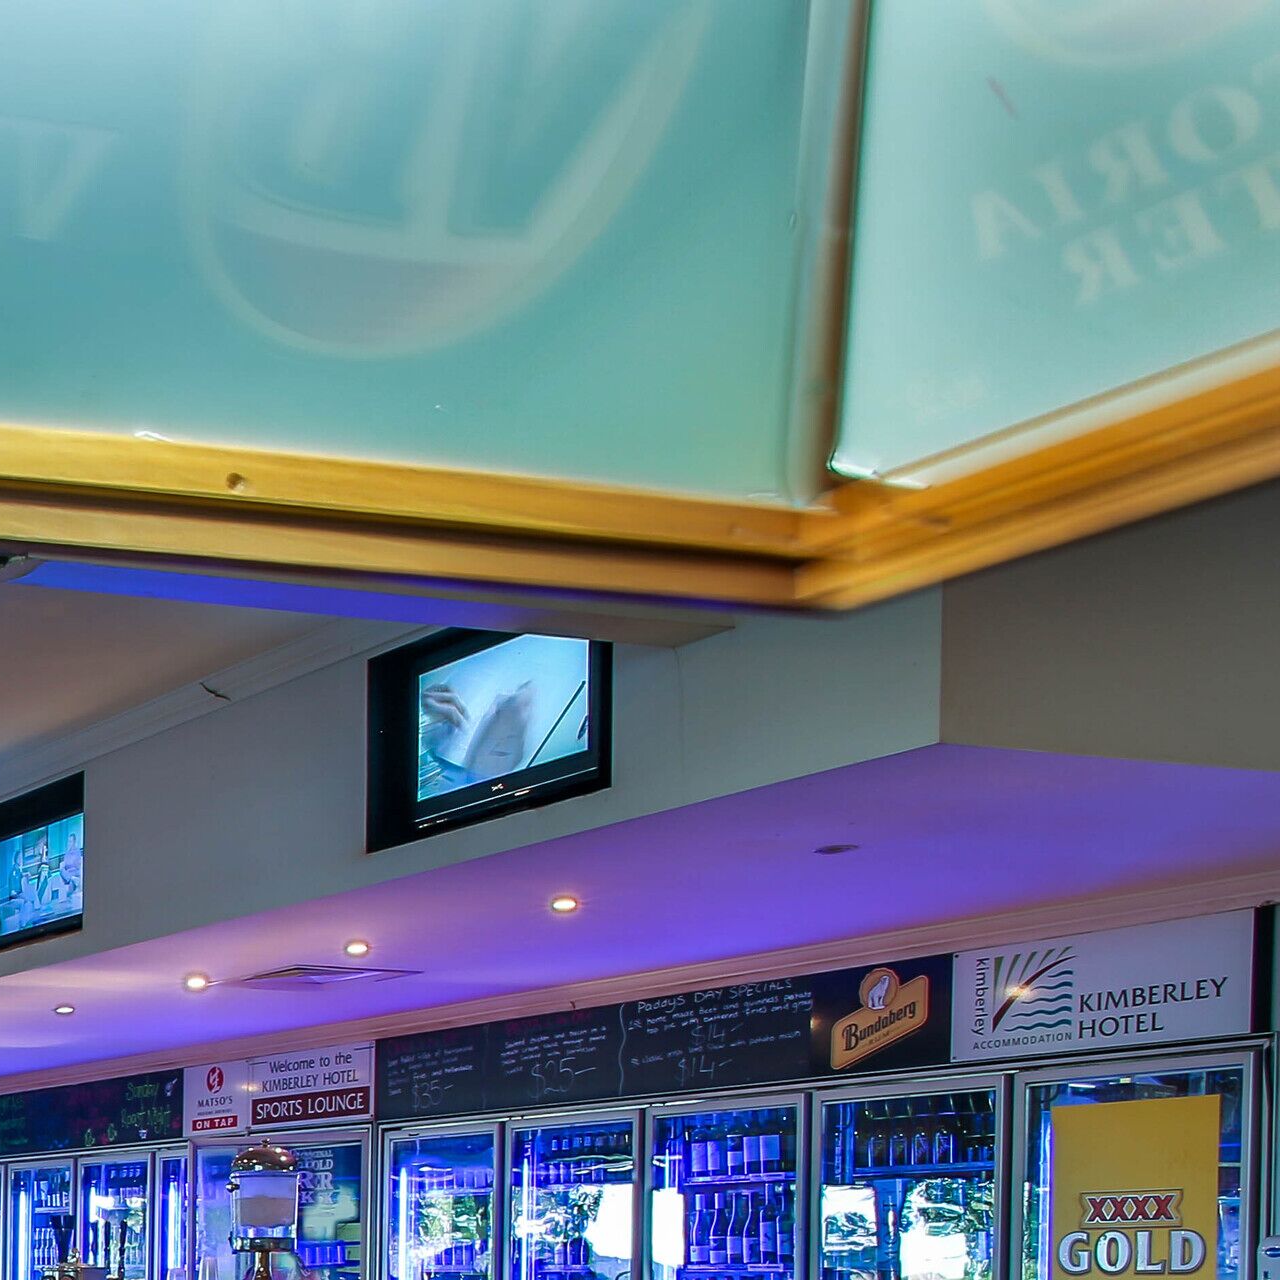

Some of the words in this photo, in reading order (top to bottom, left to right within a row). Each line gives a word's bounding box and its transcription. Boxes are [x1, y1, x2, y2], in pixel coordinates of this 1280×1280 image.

[694, 988, 723, 1003] DAY
[729, 979, 792, 999] SPECIALS
[971, 957, 990, 1036] kimberley
[1079, 976, 1229, 1013] KIMBERLEY
[842, 1001, 917, 1051] Bundaberg
[1078, 1013, 1164, 1040] HOTEL
[973, 1032, 1072, 1050] ACCOMMODATION
[269, 1058, 315, 1074] Welcome
[319, 1056, 330, 1067] to
[335, 1052, 353, 1065] the
[262, 1074, 319, 1093] KIMBERLEY
[323, 1069, 359, 1086] HOTEL
[197, 1095, 233, 1107] MATSO'S
[256, 1099, 302, 1119] SPORTS
[307, 1093, 365, 1114] LOUNGE
[196, 1120, 210, 1129] ON
[214, 1117, 234, 1127] TAP
[1086, 1194, 1176, 1223] XXXX
[1057, 1229, 1207, 1275] GOLD
